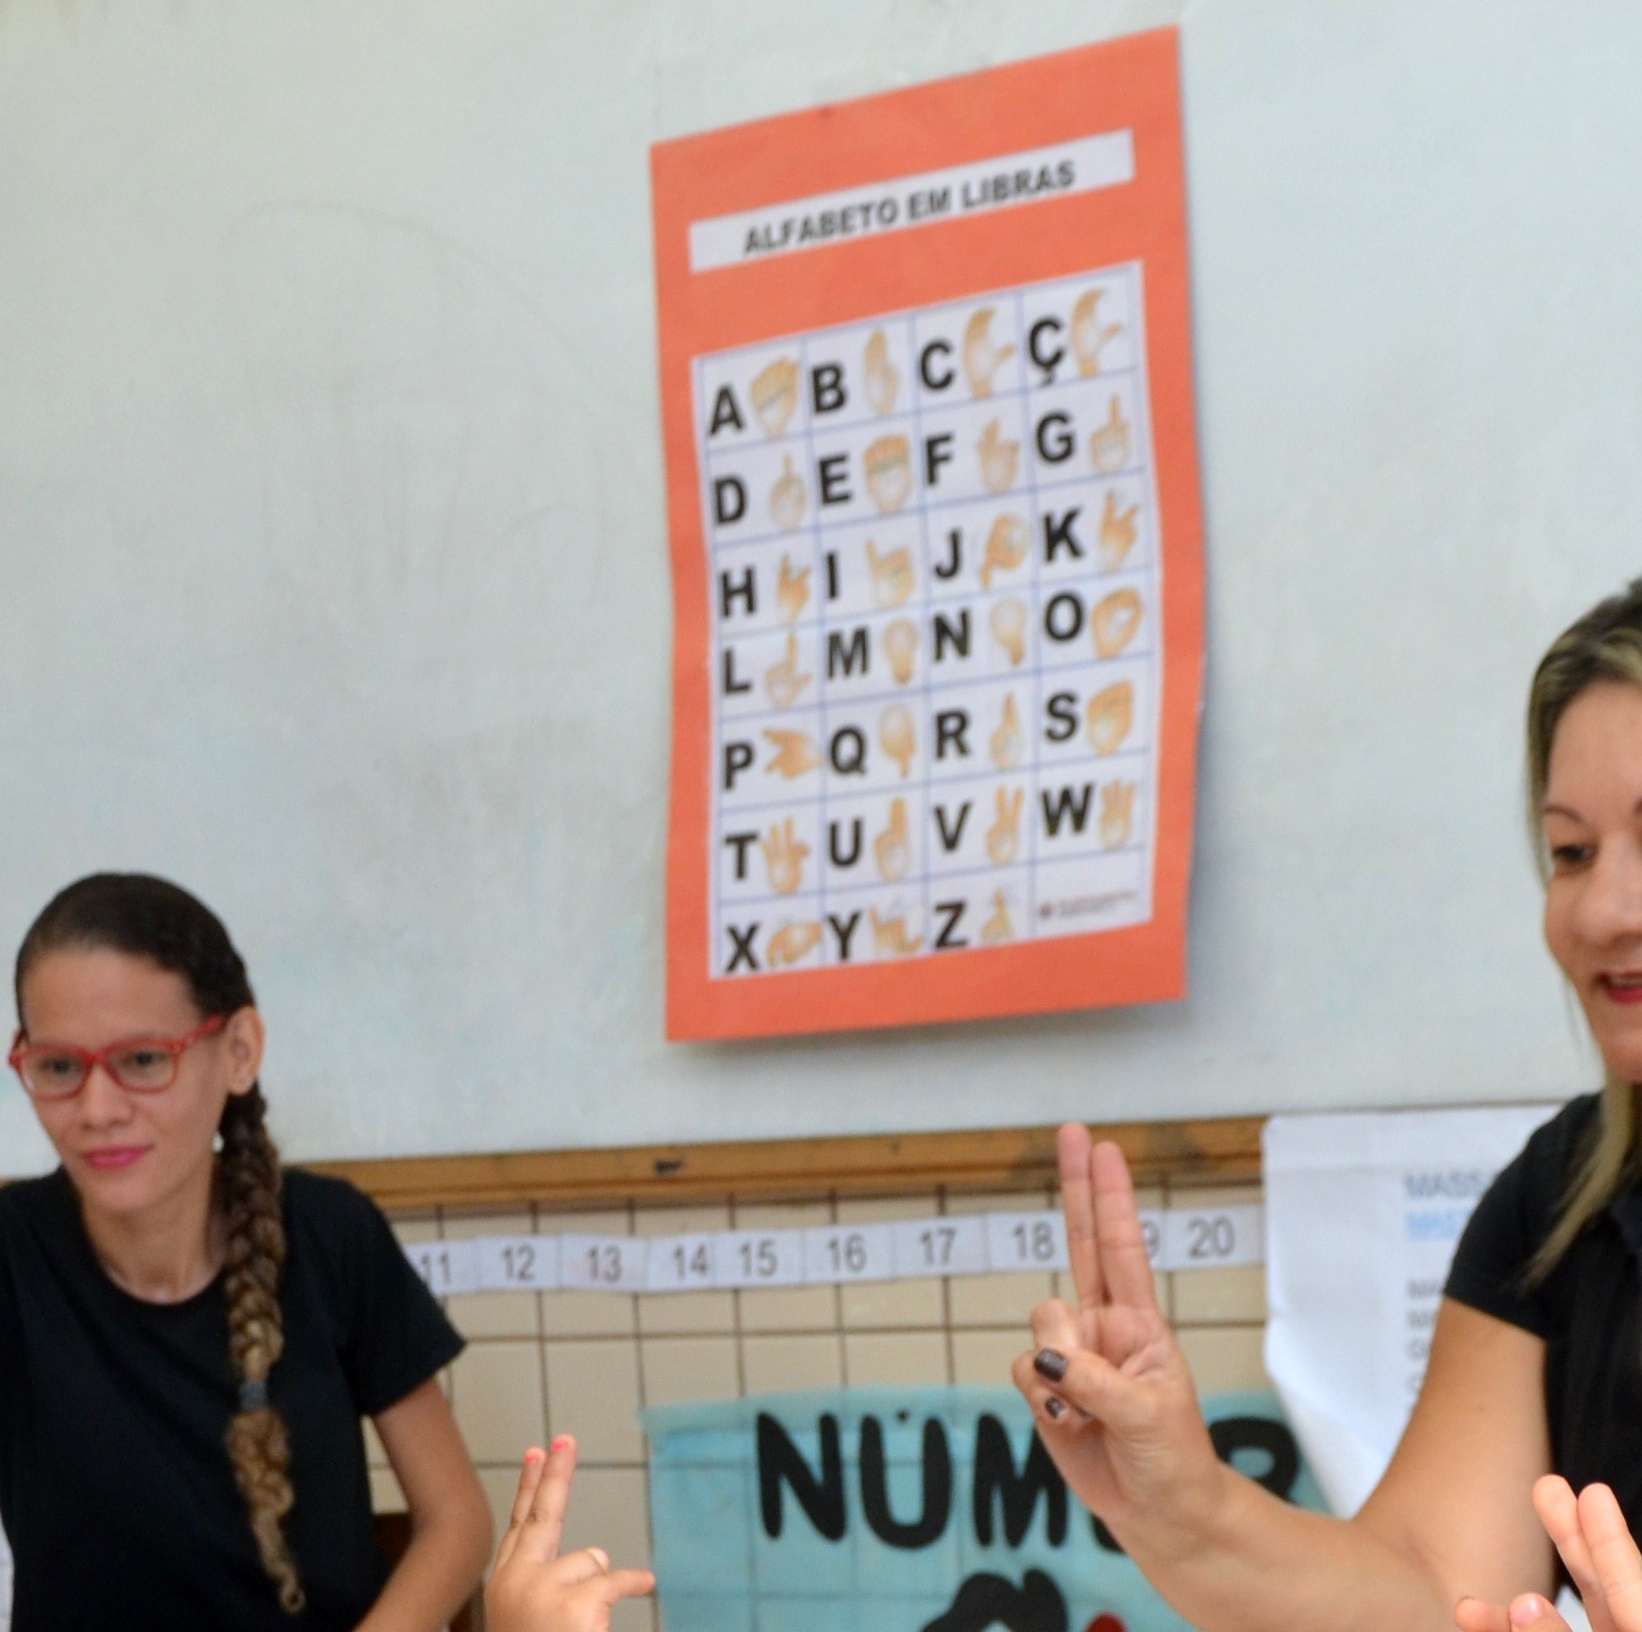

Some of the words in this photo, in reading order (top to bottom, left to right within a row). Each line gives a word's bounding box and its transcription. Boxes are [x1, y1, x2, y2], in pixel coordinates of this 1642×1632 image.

[743, 195, 900, 255] ALFABETO
[908, 186, 951, 221] EM
[962, 160, 1077, 210] LIBRAS
[710, 387, 743, 435] A
[812, 365, 845, 413] B
[920, 342, 953, 390] C
[1029, 319, 1063, 383] Ç
[715, 478, 746, 524] D
[819, 456, 850, 504] E
[926, 435, 951, 484] F
[1036, 413, 1073, 463] G
[721, 569, 755, 617] H
[827, 554, 836, 598] I
[935, 532, 960, 579] J
[1044, 511, 1080, 561] K
[723, 650, 750, 694] L
[828, 629, 868, 677] M
[934, 611, 969, 660] N
[1045, 593, 1083, 642] O
[724, 743, 753, 789] P
[830, 727, 865, 774] Q
[936, 711, 968, 758] R
[1046, 693, 1077, 741] S
[725, 833, 757, 879] T
[830, 820, 861, 867] U
[934, 804, 969, 851] V
[1042, 785, 1092, 836] W
[727, 925, 757, 972] X
[828, 913, 859, 960] Y
[935, 902, 965, 950] Z
[502, 1245, 535, 1281] 12
[588, 1247, 622, 1283] 13
[674, 1245, 709, 1276] 14
[740, 1240, 777, 1277] 15
[828, 1234, 866, 1272] 16
[920, 1227, 956, 1263] 17
[1014, 1222, 1054, 1260] 18
[1189, 1216, 1235, 1259] 20
